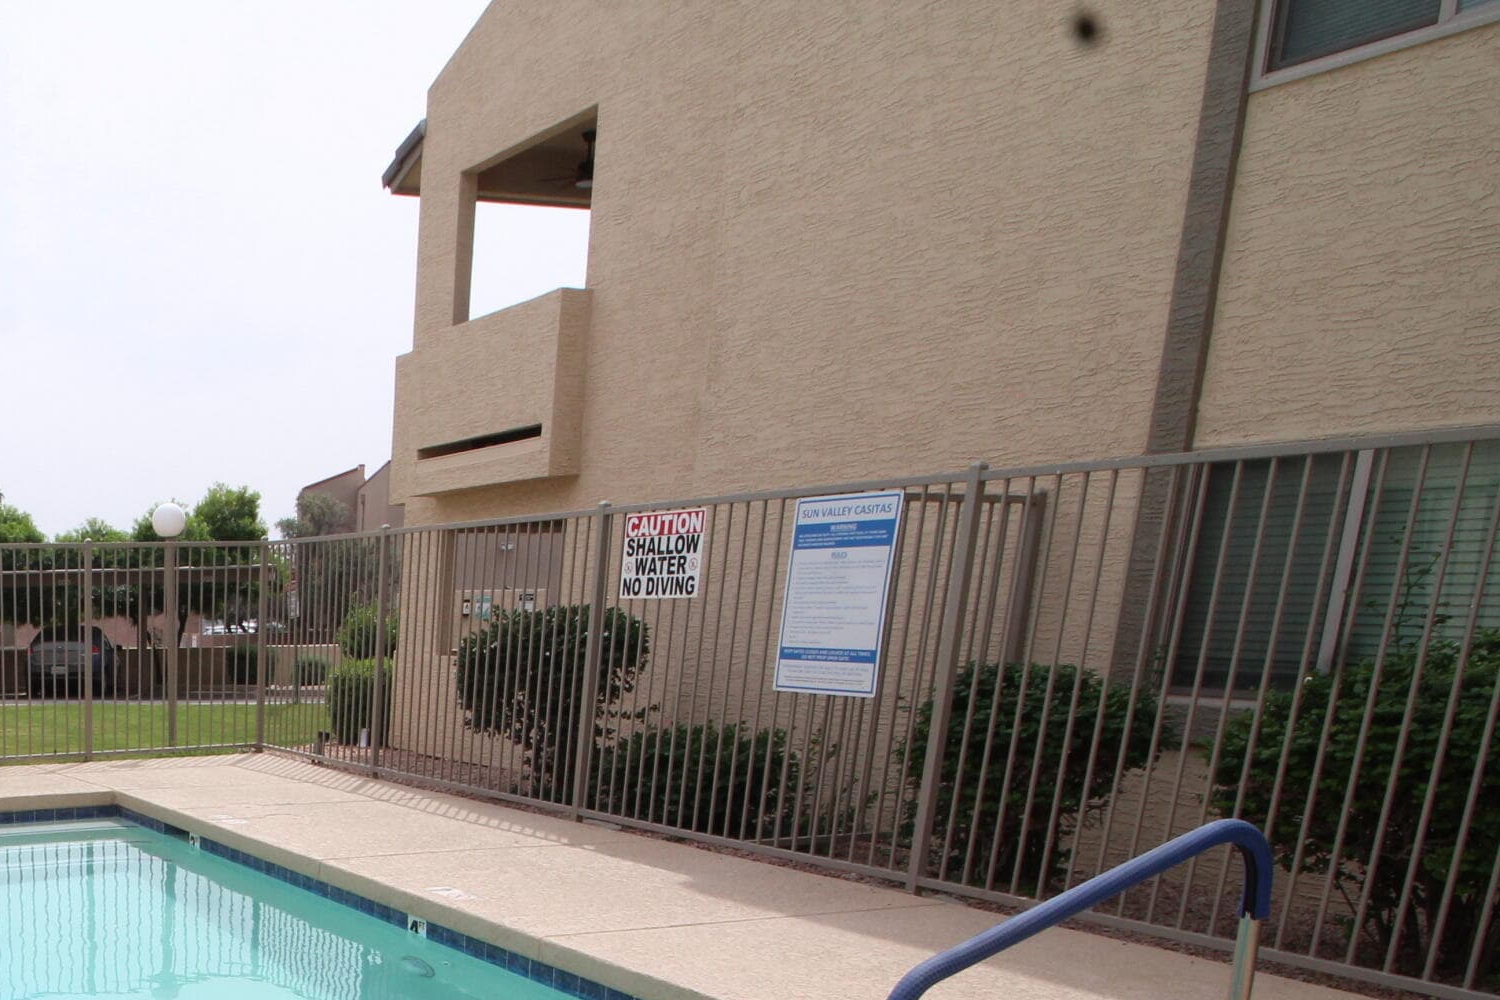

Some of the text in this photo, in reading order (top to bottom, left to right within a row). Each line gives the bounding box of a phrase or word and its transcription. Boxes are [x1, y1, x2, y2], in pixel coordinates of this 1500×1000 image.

[802, 503, 892, 519] SUN VALLEY CASITAS
[627, 511, 703, 537] CAUTION
[626, 534, 700, 557] SHALLOW
[635, 555, 687, 576] WATER
[622, 575, 695, 596] NO DIVING
